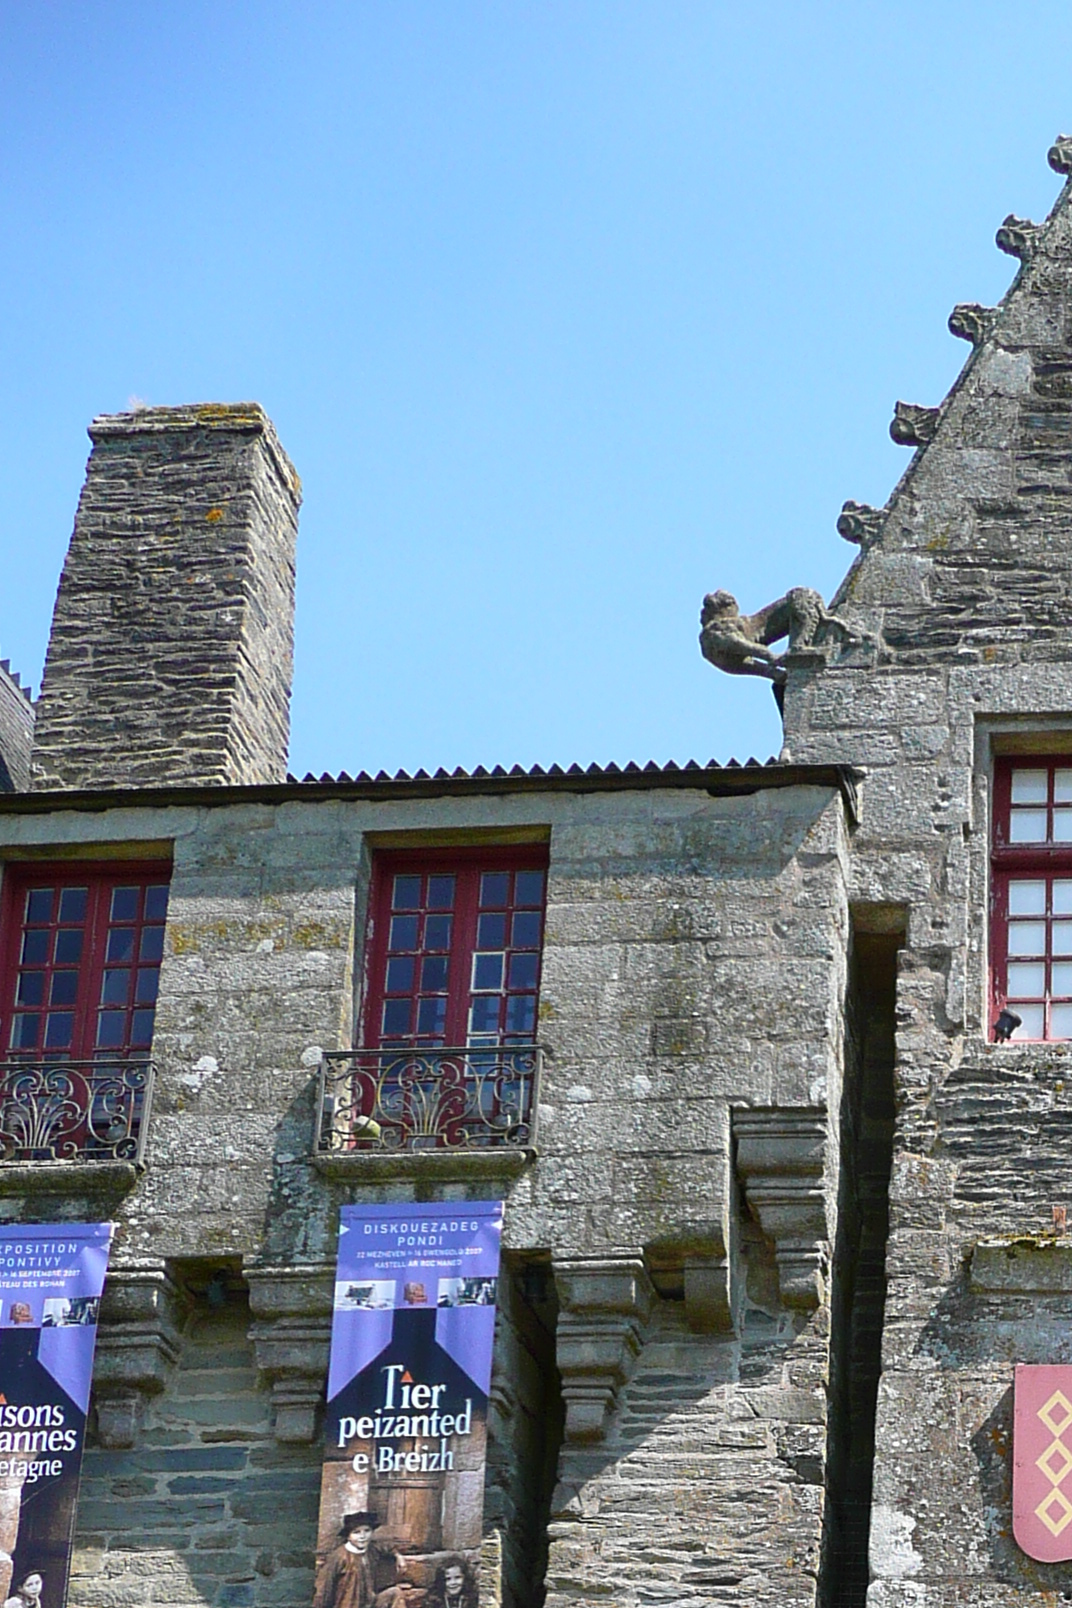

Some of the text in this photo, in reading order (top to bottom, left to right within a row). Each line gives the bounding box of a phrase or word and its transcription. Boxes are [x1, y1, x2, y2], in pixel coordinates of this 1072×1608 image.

[364, 1221, 479, 1234] DISKOUEZADEG
[397, 1235, 443, 1247] PONDI
[380, 1364, 447, 1410] Tier
[336, 1398, 472, 1448] peizanted
[352, 1438, 454, 1474] e Breizh
